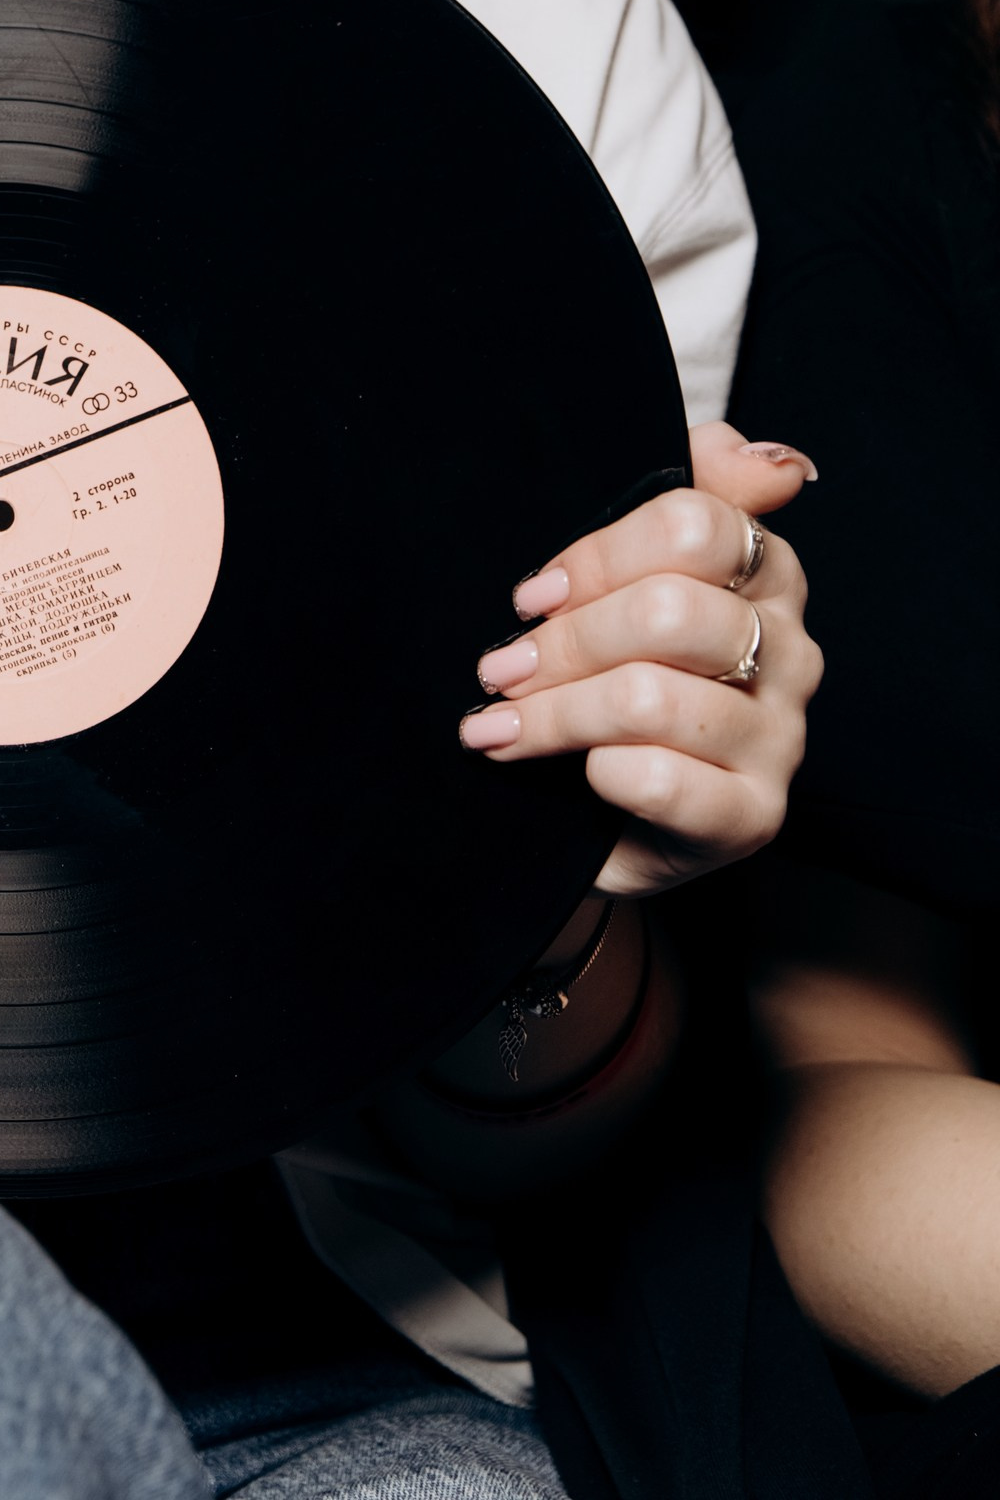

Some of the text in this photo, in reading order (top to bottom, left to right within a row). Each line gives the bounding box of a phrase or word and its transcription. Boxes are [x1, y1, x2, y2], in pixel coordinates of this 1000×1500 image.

[43, 330, 97, 358] СССР
[114, 381, 139, 403] 33
[49, 423, 90, 446] ЗАВОД
[72, 472, 135, 502] 2 сторона
[72, 487, 137, 520] Гр. 2. 1-20
[2, 548, 72, 582] БИЧЕВСКАЯ
[22, 547, 110, 585] исполнительница
[2, 581, 52, 604] народных
[56, 567, 85, 584] песен
[5, 592, 47, 614] МЕСЯЦ
[50, 563, 123, 596] БАГРЯНЦЕМ
[29, 584, 96, 616] КОМАРИКИ
[39, 592, 132, 634] ПОДРУЖЕНЬКИ
[45, 590, 109, 622] ДОЛЮШКА
[40, 629, 70, 646] пение
[73, 625, 80, 633] и
[83, 610, 118, 630] гитара
[49, 630, 97, 653] колокола
[101, 622, 116, 635] (6)
[16, 648, 77, 678] скрипка (5)
